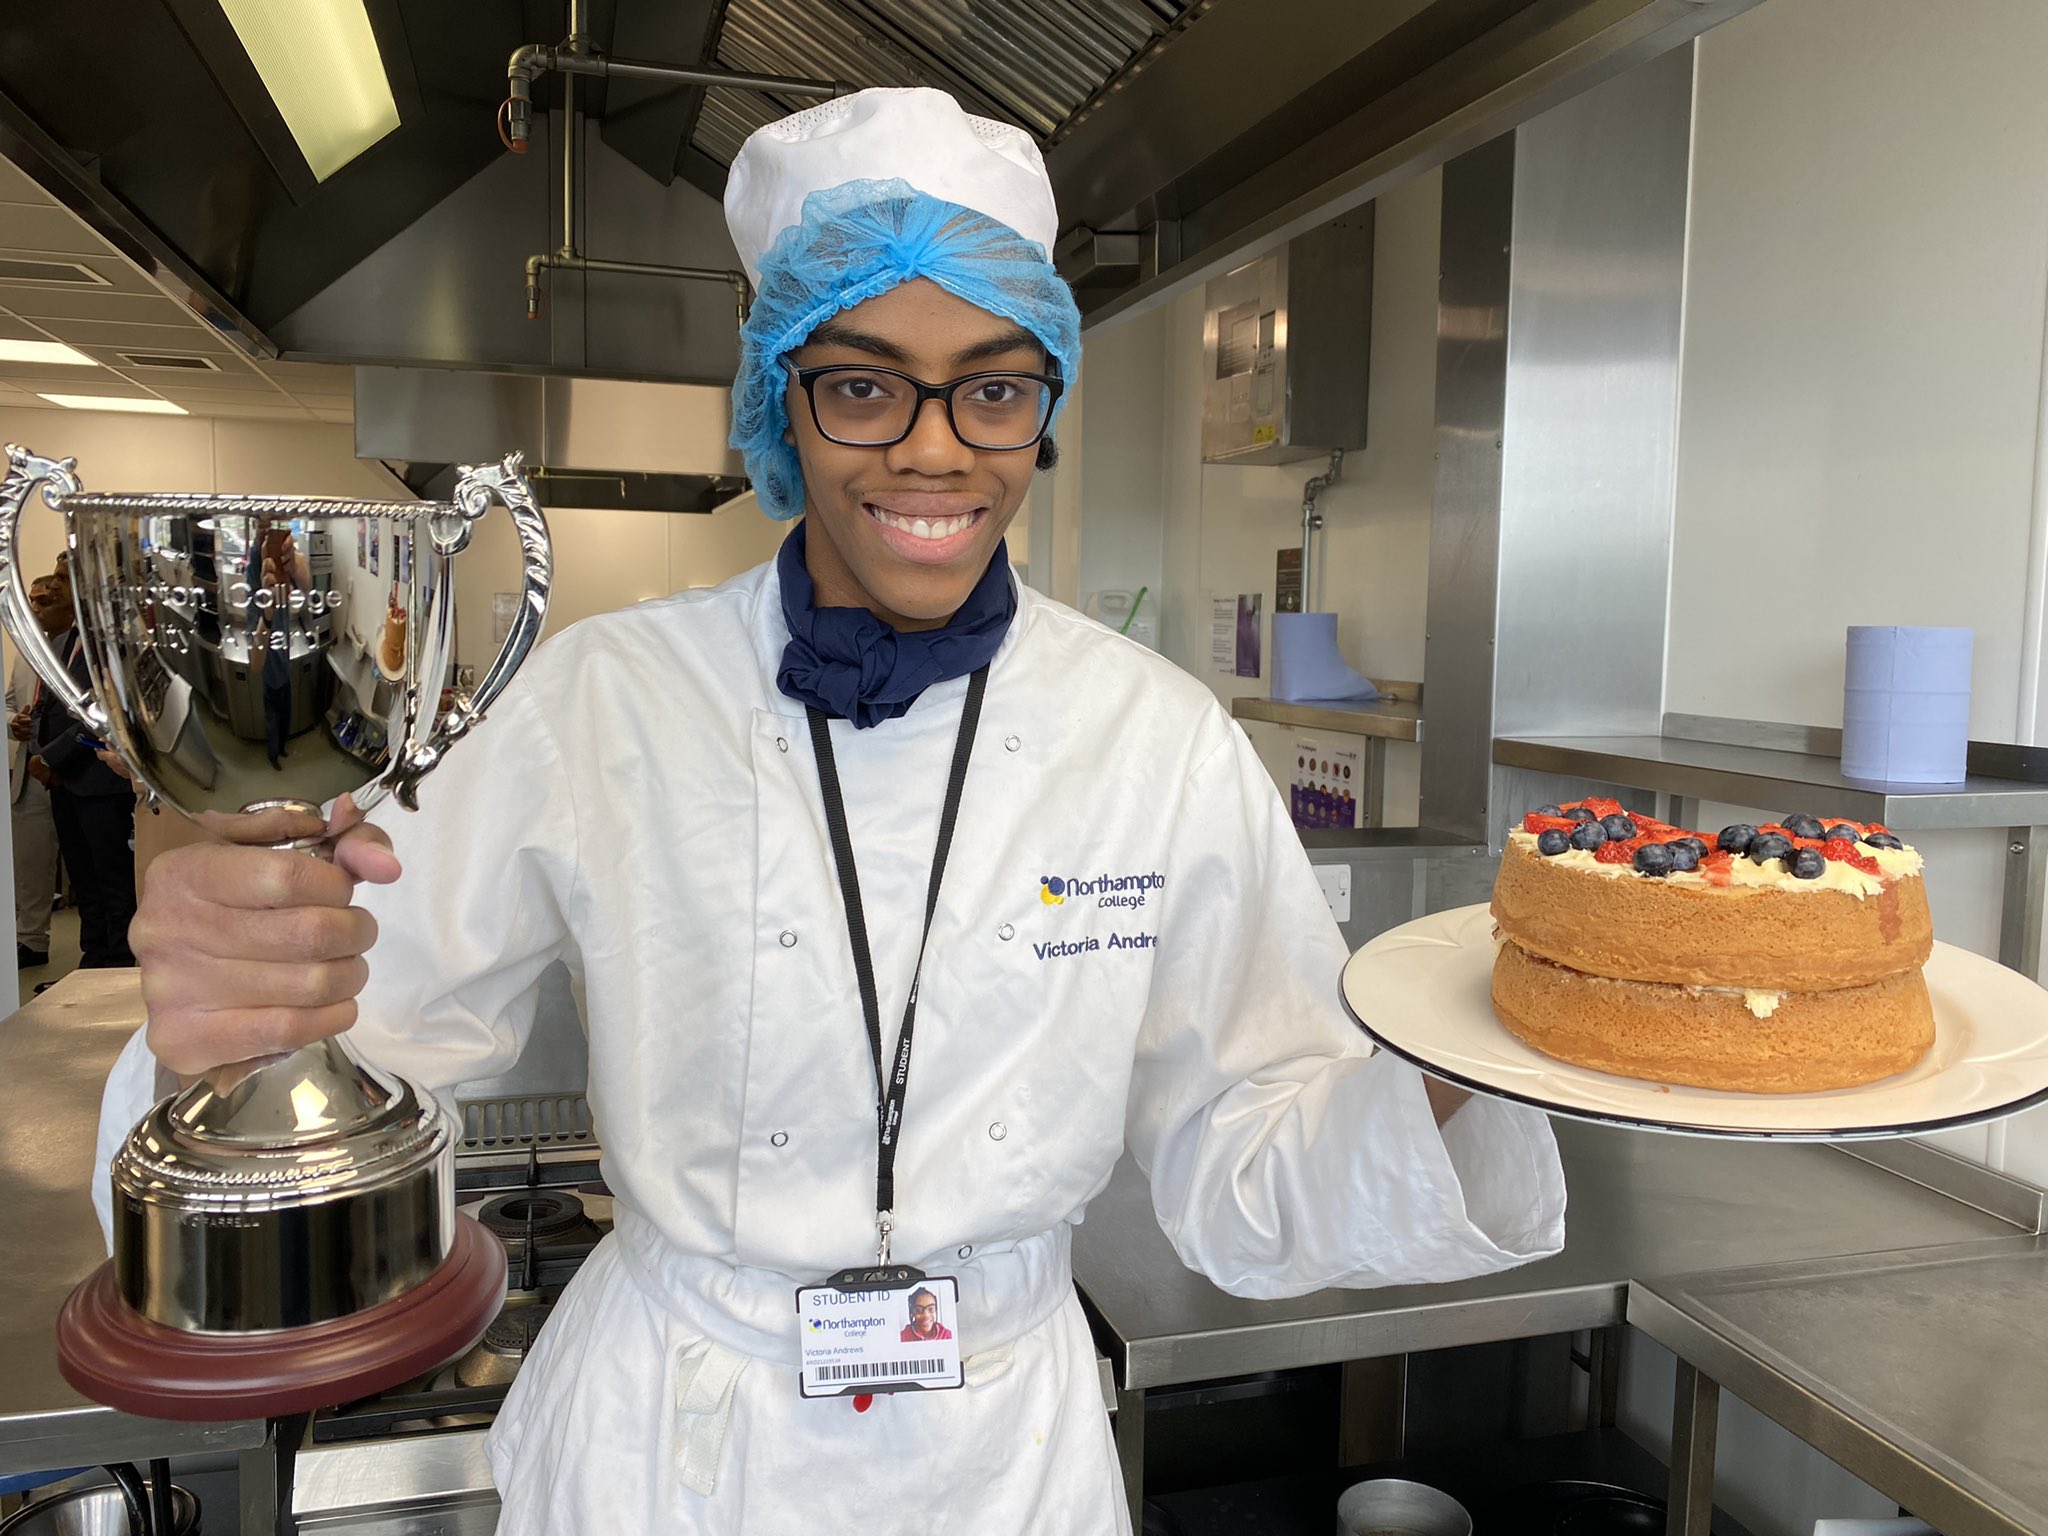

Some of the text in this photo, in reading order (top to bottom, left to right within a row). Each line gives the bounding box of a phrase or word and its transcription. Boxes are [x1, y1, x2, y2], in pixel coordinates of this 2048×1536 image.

[229, 582, 342, 614] College
[1033, 936, 1100, 961] Victoria
[896, 1038, 910, 1085] STUDENT
[812, 1290, 891, 1307] STUDENT ID
[823, 1316, 886, 1331] Northampton
[805, 1345, 864, 1358] Victoria Andrews
